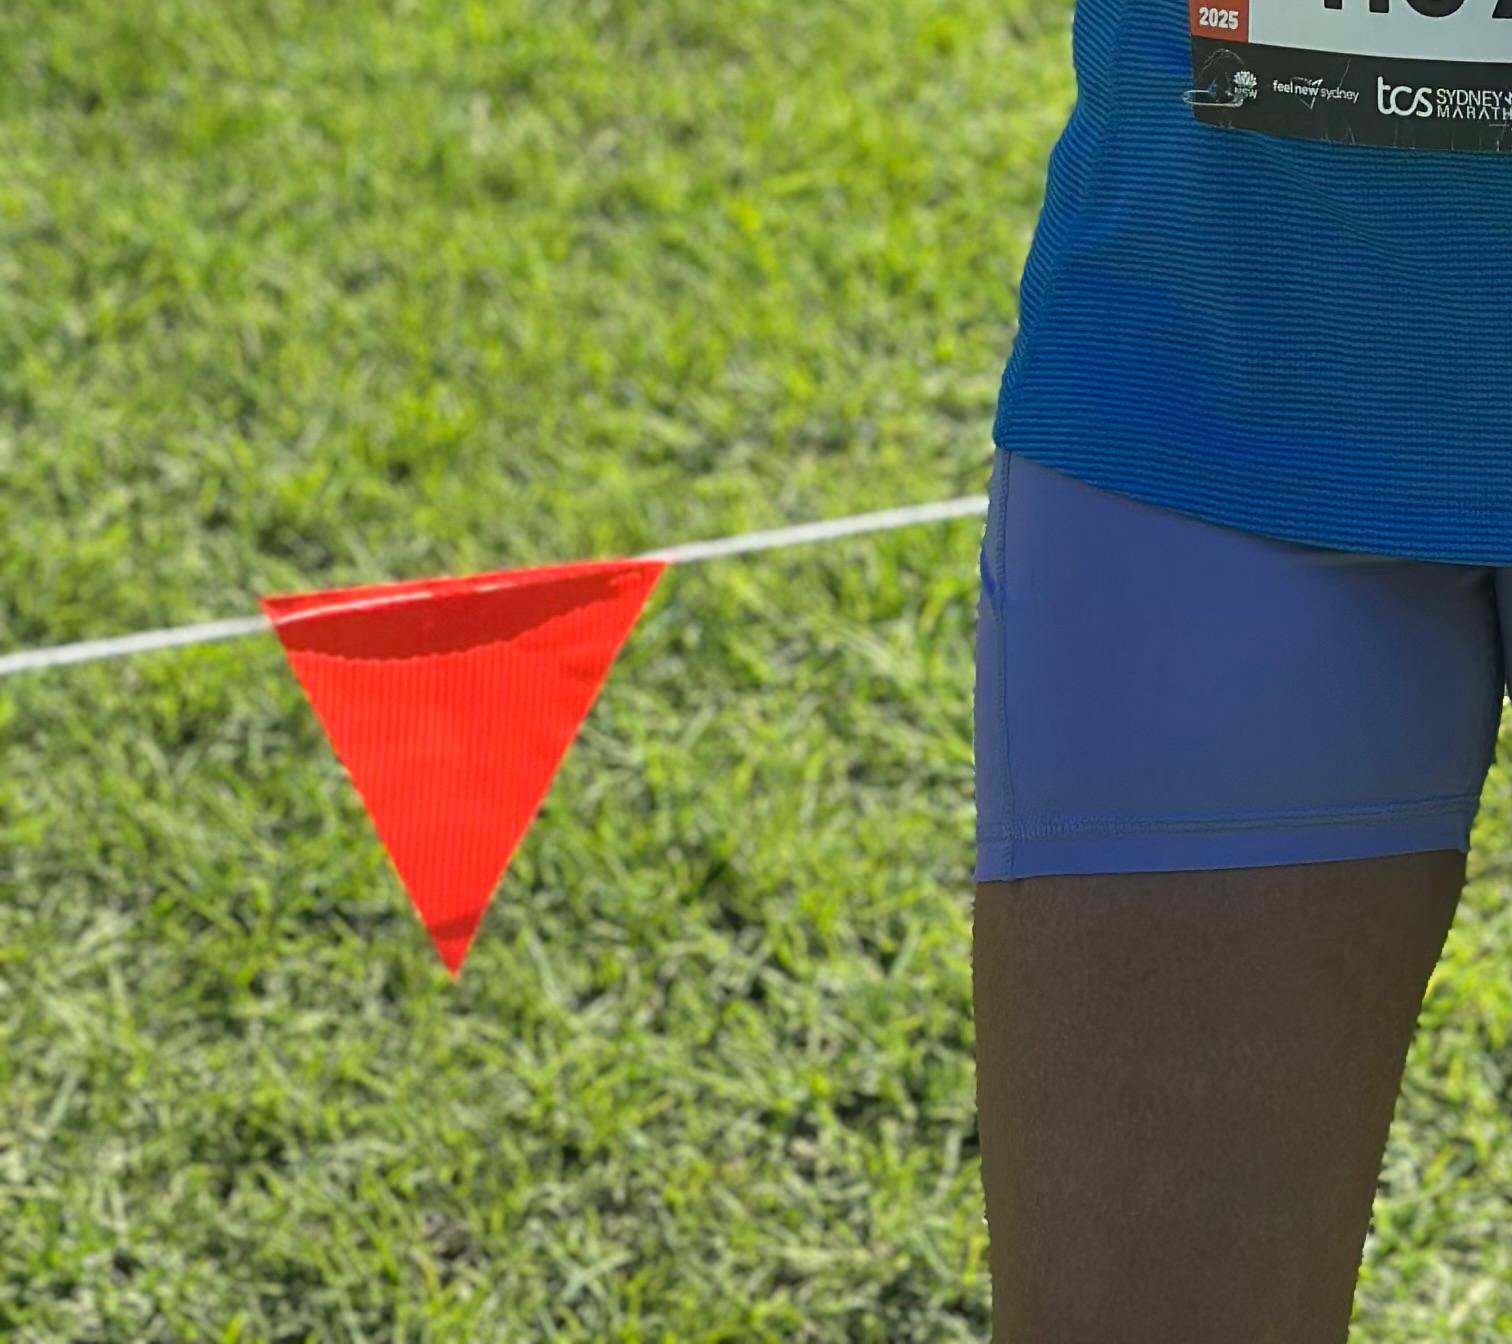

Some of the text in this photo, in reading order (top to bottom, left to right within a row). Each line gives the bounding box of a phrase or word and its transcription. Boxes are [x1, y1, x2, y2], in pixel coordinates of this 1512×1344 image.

[1199, 7, 1239, 30] 2025
[1273, 79, 1360, 104] feel new sydney
[1377, 76, 1433, 117] tcs
[1436, 88, 1503, 107] SYDNEY
